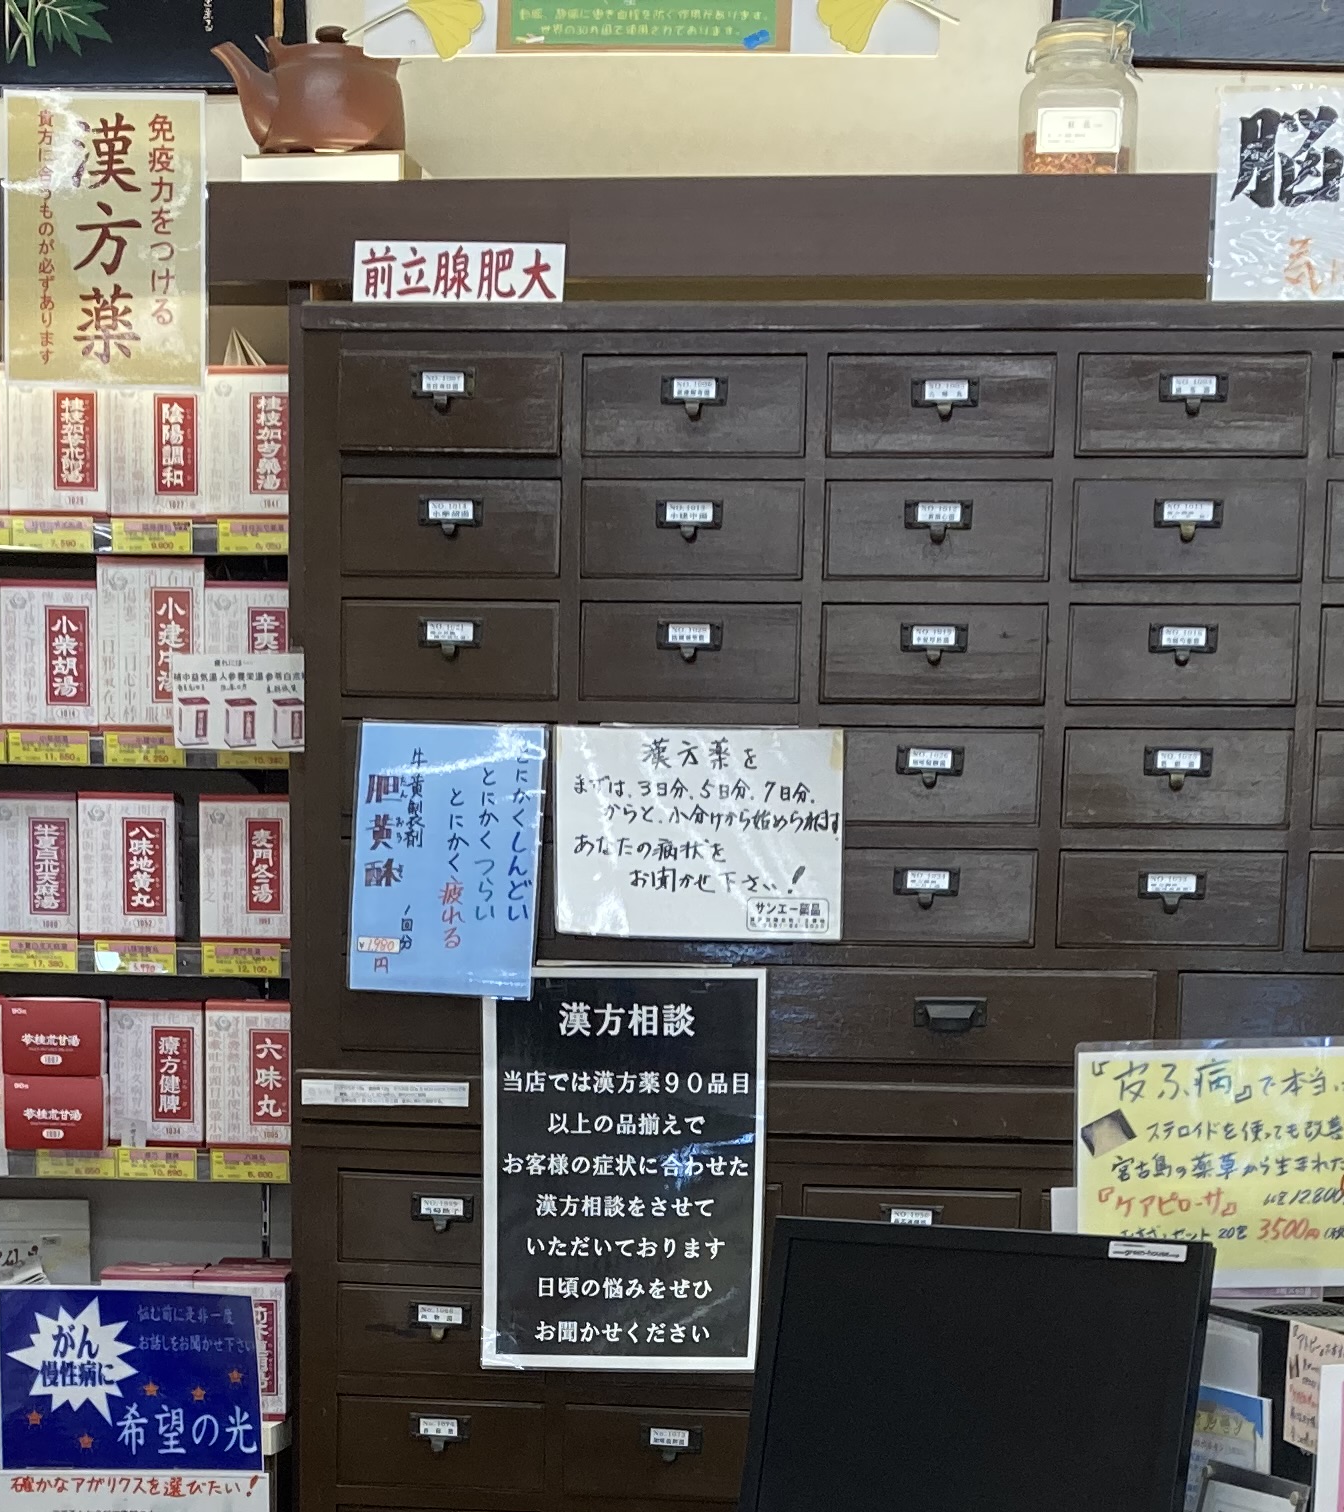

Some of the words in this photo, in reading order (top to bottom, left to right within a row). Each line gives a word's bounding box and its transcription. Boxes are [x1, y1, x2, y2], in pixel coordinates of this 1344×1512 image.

[148, 113, 176, 326] 免疫力をつける
[73, 113, 142, 365] 漢方薬
[362, 246, 557, 301] 前立腺肥大
[51, 615, 79, 698] 小柴胡湯
[641, 737, 758, 770] 漢方薬を
[475, 767, 499, 921] とにかくつらい
[128, 826, 154, 909] 八味地黄丸
[558, 1002, 696, 1037] 漢方相談
[255, 1038, 283, 1118] 六味丸
[548, 1113, 705, 1136] 以上の品揃えで
[502, 1153, 749, 1178] お客様の症状に合わせた
[535, 1193, 715, 1218] 漢方相談をさせて
[526, 1236, 726, 1259] いただいております
[537, 1277, 712, 1300] 日頃の悩みをぜひ
[52, 1324, 99, 1359] がん
[534, 1321, 711, 1344] お聞かせください
[40, 1360, 116, 1388] 慢性病に
[116, 1401, 258, 1455] 希望の光
